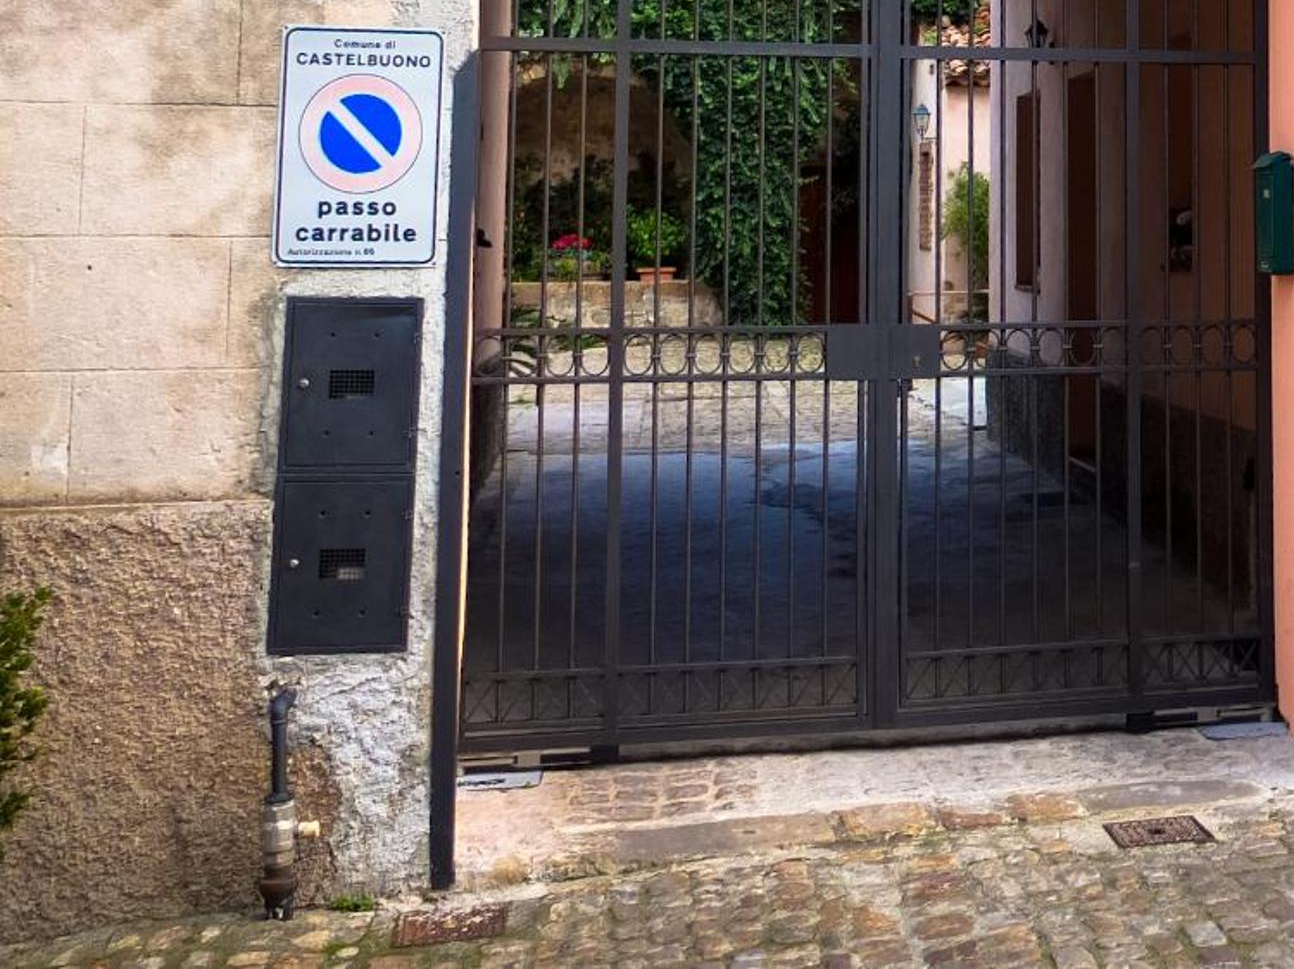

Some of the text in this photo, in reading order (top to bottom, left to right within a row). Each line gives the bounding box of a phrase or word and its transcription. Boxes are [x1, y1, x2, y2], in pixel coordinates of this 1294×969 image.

[334, 38, 396, 49] Comune di
[296, 52, 431, 67] CASTELBUONO
[318, 201, 396, 219] passo
[295, 223, 416, 241] carrabile
